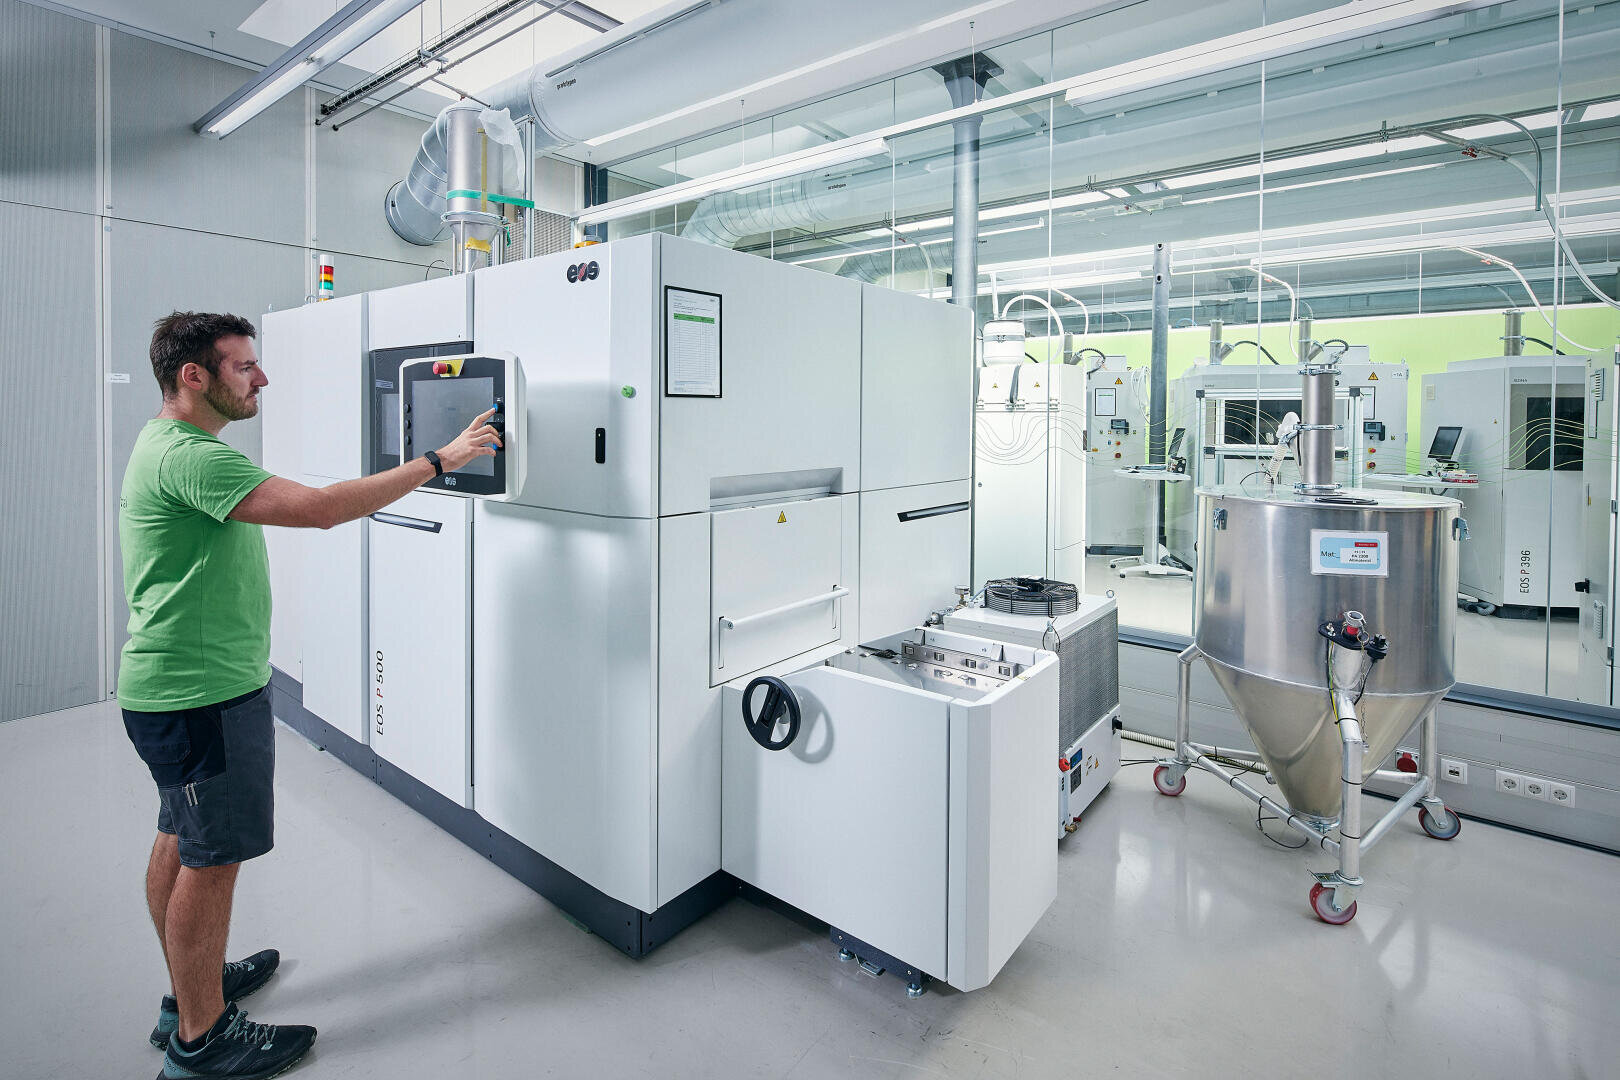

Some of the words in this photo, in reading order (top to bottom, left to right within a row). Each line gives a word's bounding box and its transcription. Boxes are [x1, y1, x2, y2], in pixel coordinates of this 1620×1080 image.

[1520, 550, 1531, 568] 396
[1519, 577, 1530, 594] EOS
[376, 650, 384, 685] 500
[376, 687, 384, 698] P
[376, 703, 384, 736] EOS
